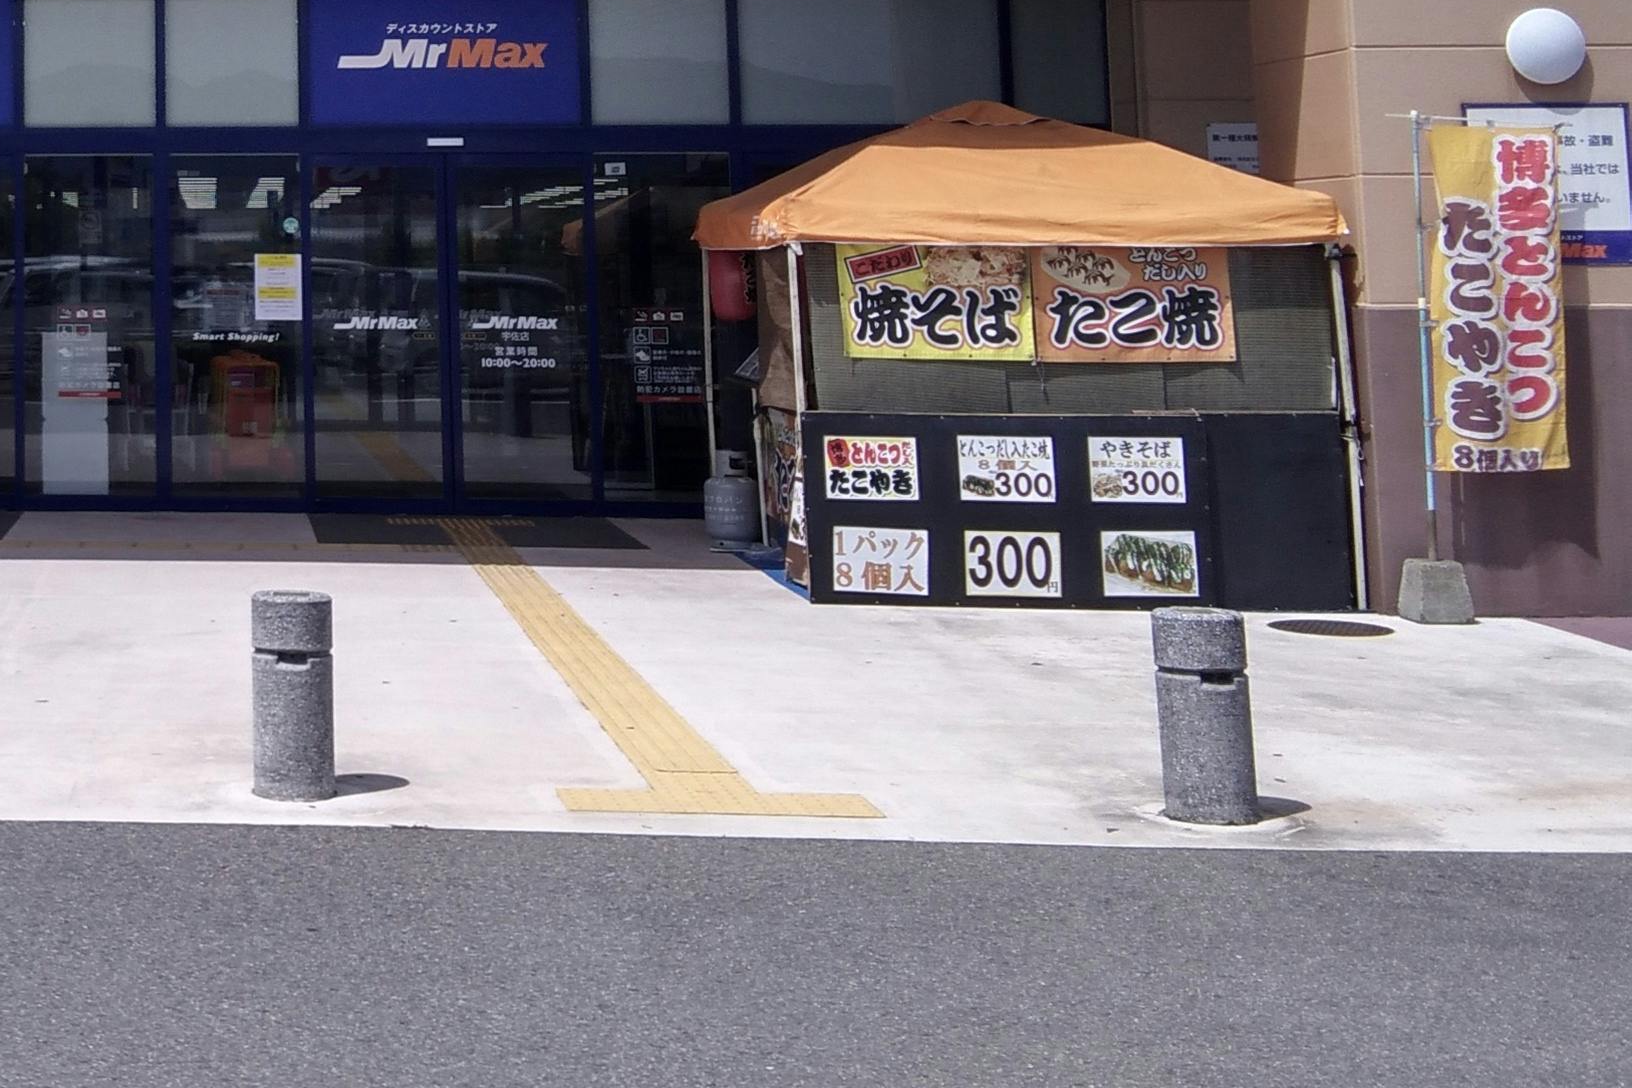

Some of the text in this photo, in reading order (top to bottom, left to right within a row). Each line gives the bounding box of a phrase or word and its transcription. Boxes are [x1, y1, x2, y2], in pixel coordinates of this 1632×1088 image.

[386, 23, 497, 34] ディスカウントストア
[337, 38, 549, 69] MrMax
[853, 253, 919, 276] こだわり
[1144, 263, 1207, 280] だし入り
[1495, 139, 1552, 414] 博多とんこつ
[334, 316, 418, 329] MrMax
[472, 316, 558, 329] MrMax
[855, 286, 1020, 345] 焼そば
[1049, 286, 1219, 346] たこ焼
[1441, 200, 1503, 435] たこやき
[192, 332, 280, 343] Smart Shopping!
[494, 346, 538, 356] 営業時間
[851, 442, 901, 464] とんこつ
[1100, 440, 1172, 458] やきそば
[1453, 448, 1540, 471] 8個入り
[829, 469, 913, 494] たこやき
[834, 530, 925, 560] 1パック
[835, 562, 925, 592] 8個入
